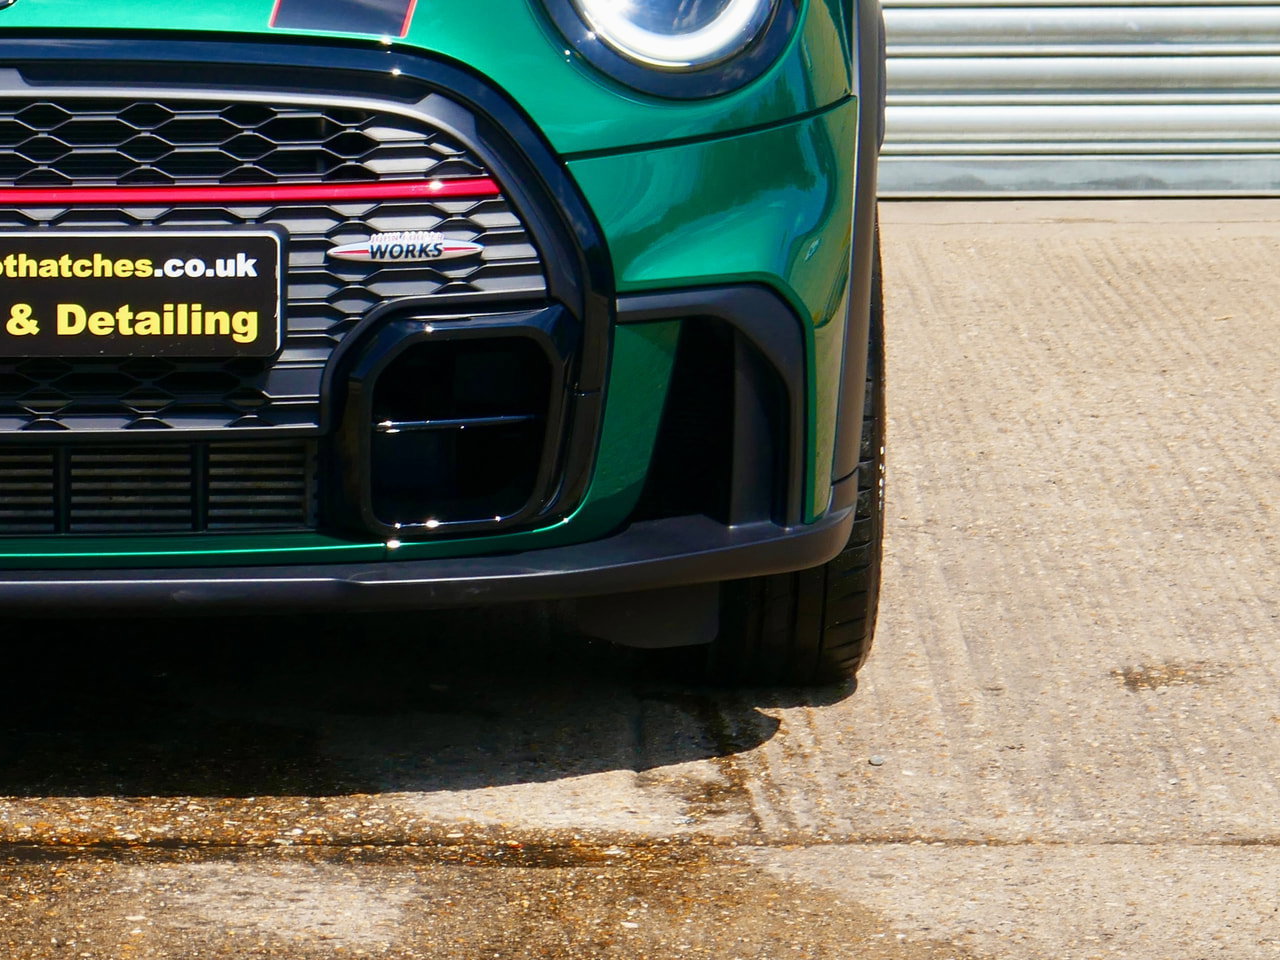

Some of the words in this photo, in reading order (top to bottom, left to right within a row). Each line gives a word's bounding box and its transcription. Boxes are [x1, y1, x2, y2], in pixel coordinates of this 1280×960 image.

[369, 242, 443, 260] WORKS
[5, 303, 41, 336] &
[56, 302, 258, 344] Detailing
